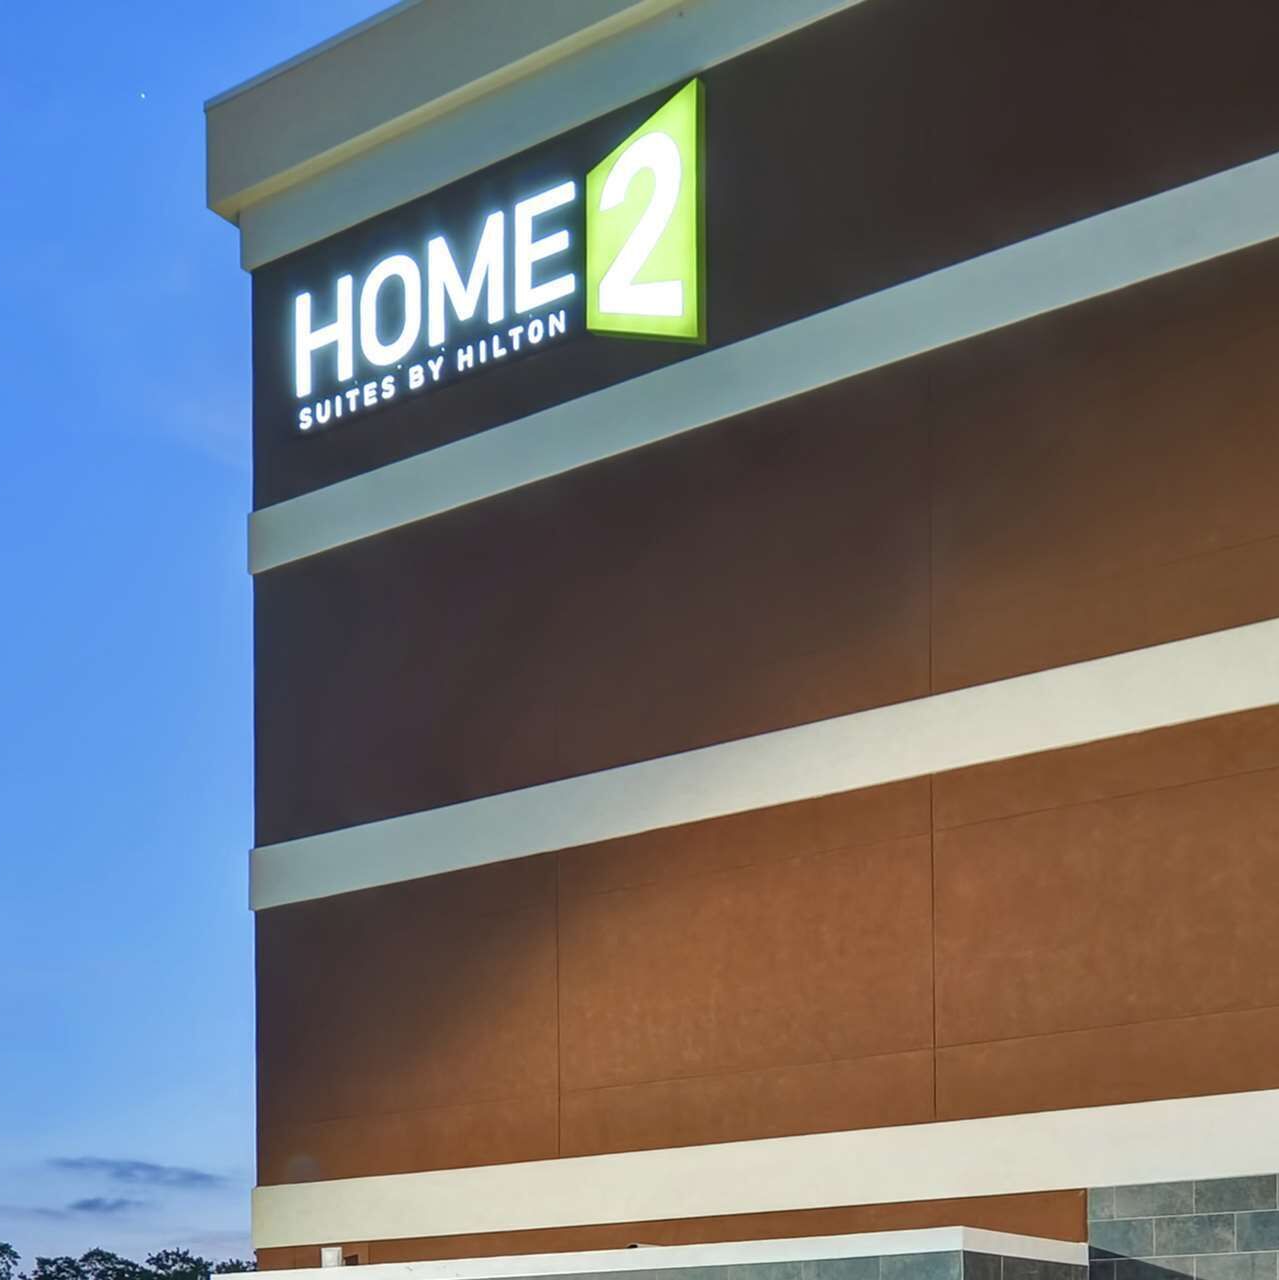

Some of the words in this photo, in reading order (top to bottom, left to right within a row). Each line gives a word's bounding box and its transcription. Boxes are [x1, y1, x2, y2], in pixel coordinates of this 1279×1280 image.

[295, 180, 576, 398] HOME
[597, 131, 683, 317] 2
[298, 374, 397, 431] SUITES
[408, 355, 445, 391] BY
[456, 310, 566, 372] HILTON
